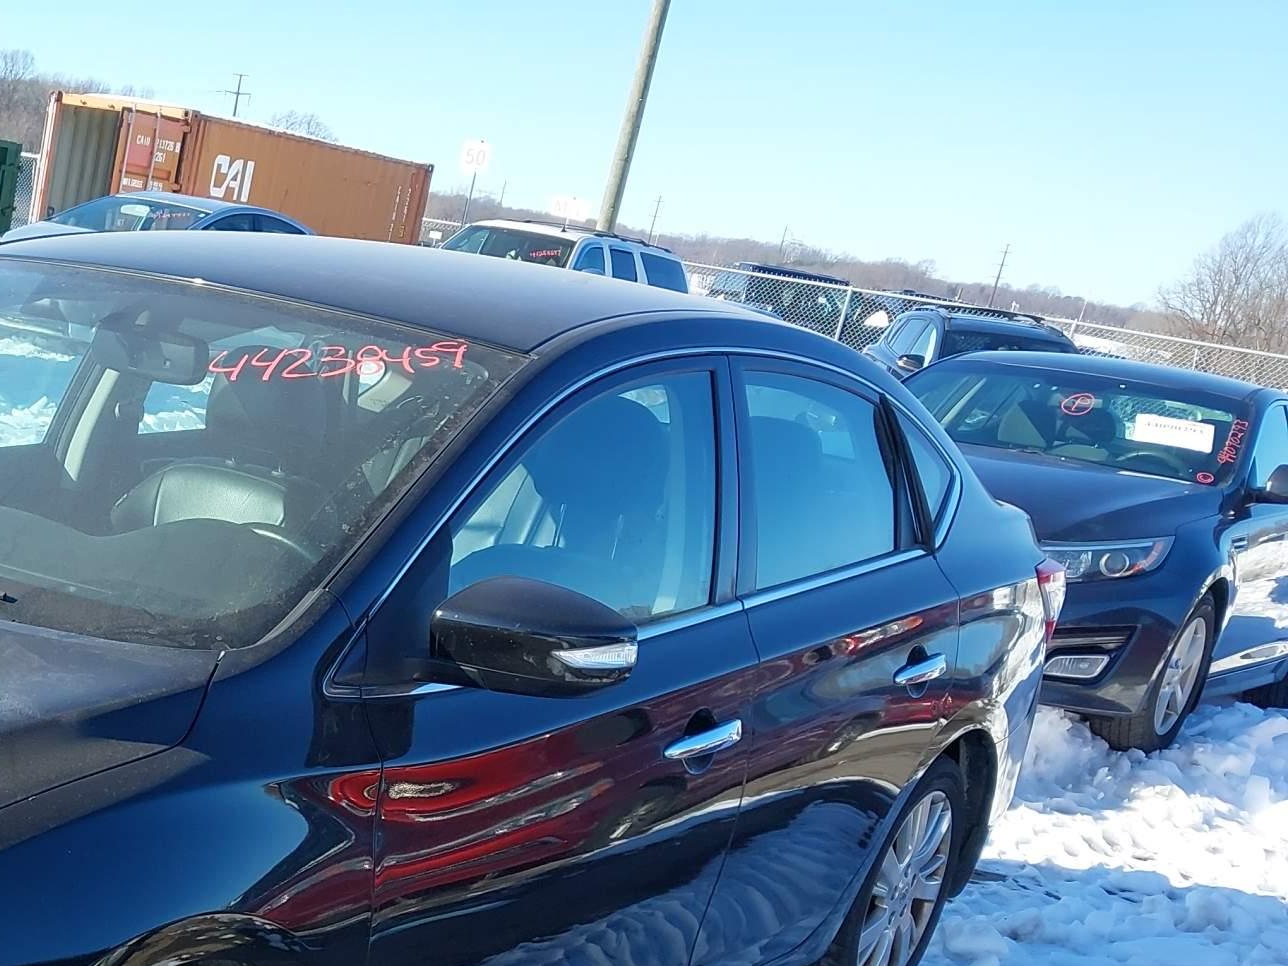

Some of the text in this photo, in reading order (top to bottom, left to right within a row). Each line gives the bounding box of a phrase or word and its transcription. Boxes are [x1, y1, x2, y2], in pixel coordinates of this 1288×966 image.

[210, 154, 255, 203] CAI
[465, 148, 486, 166] 50
[209, 339, 468, 382] 44238459
